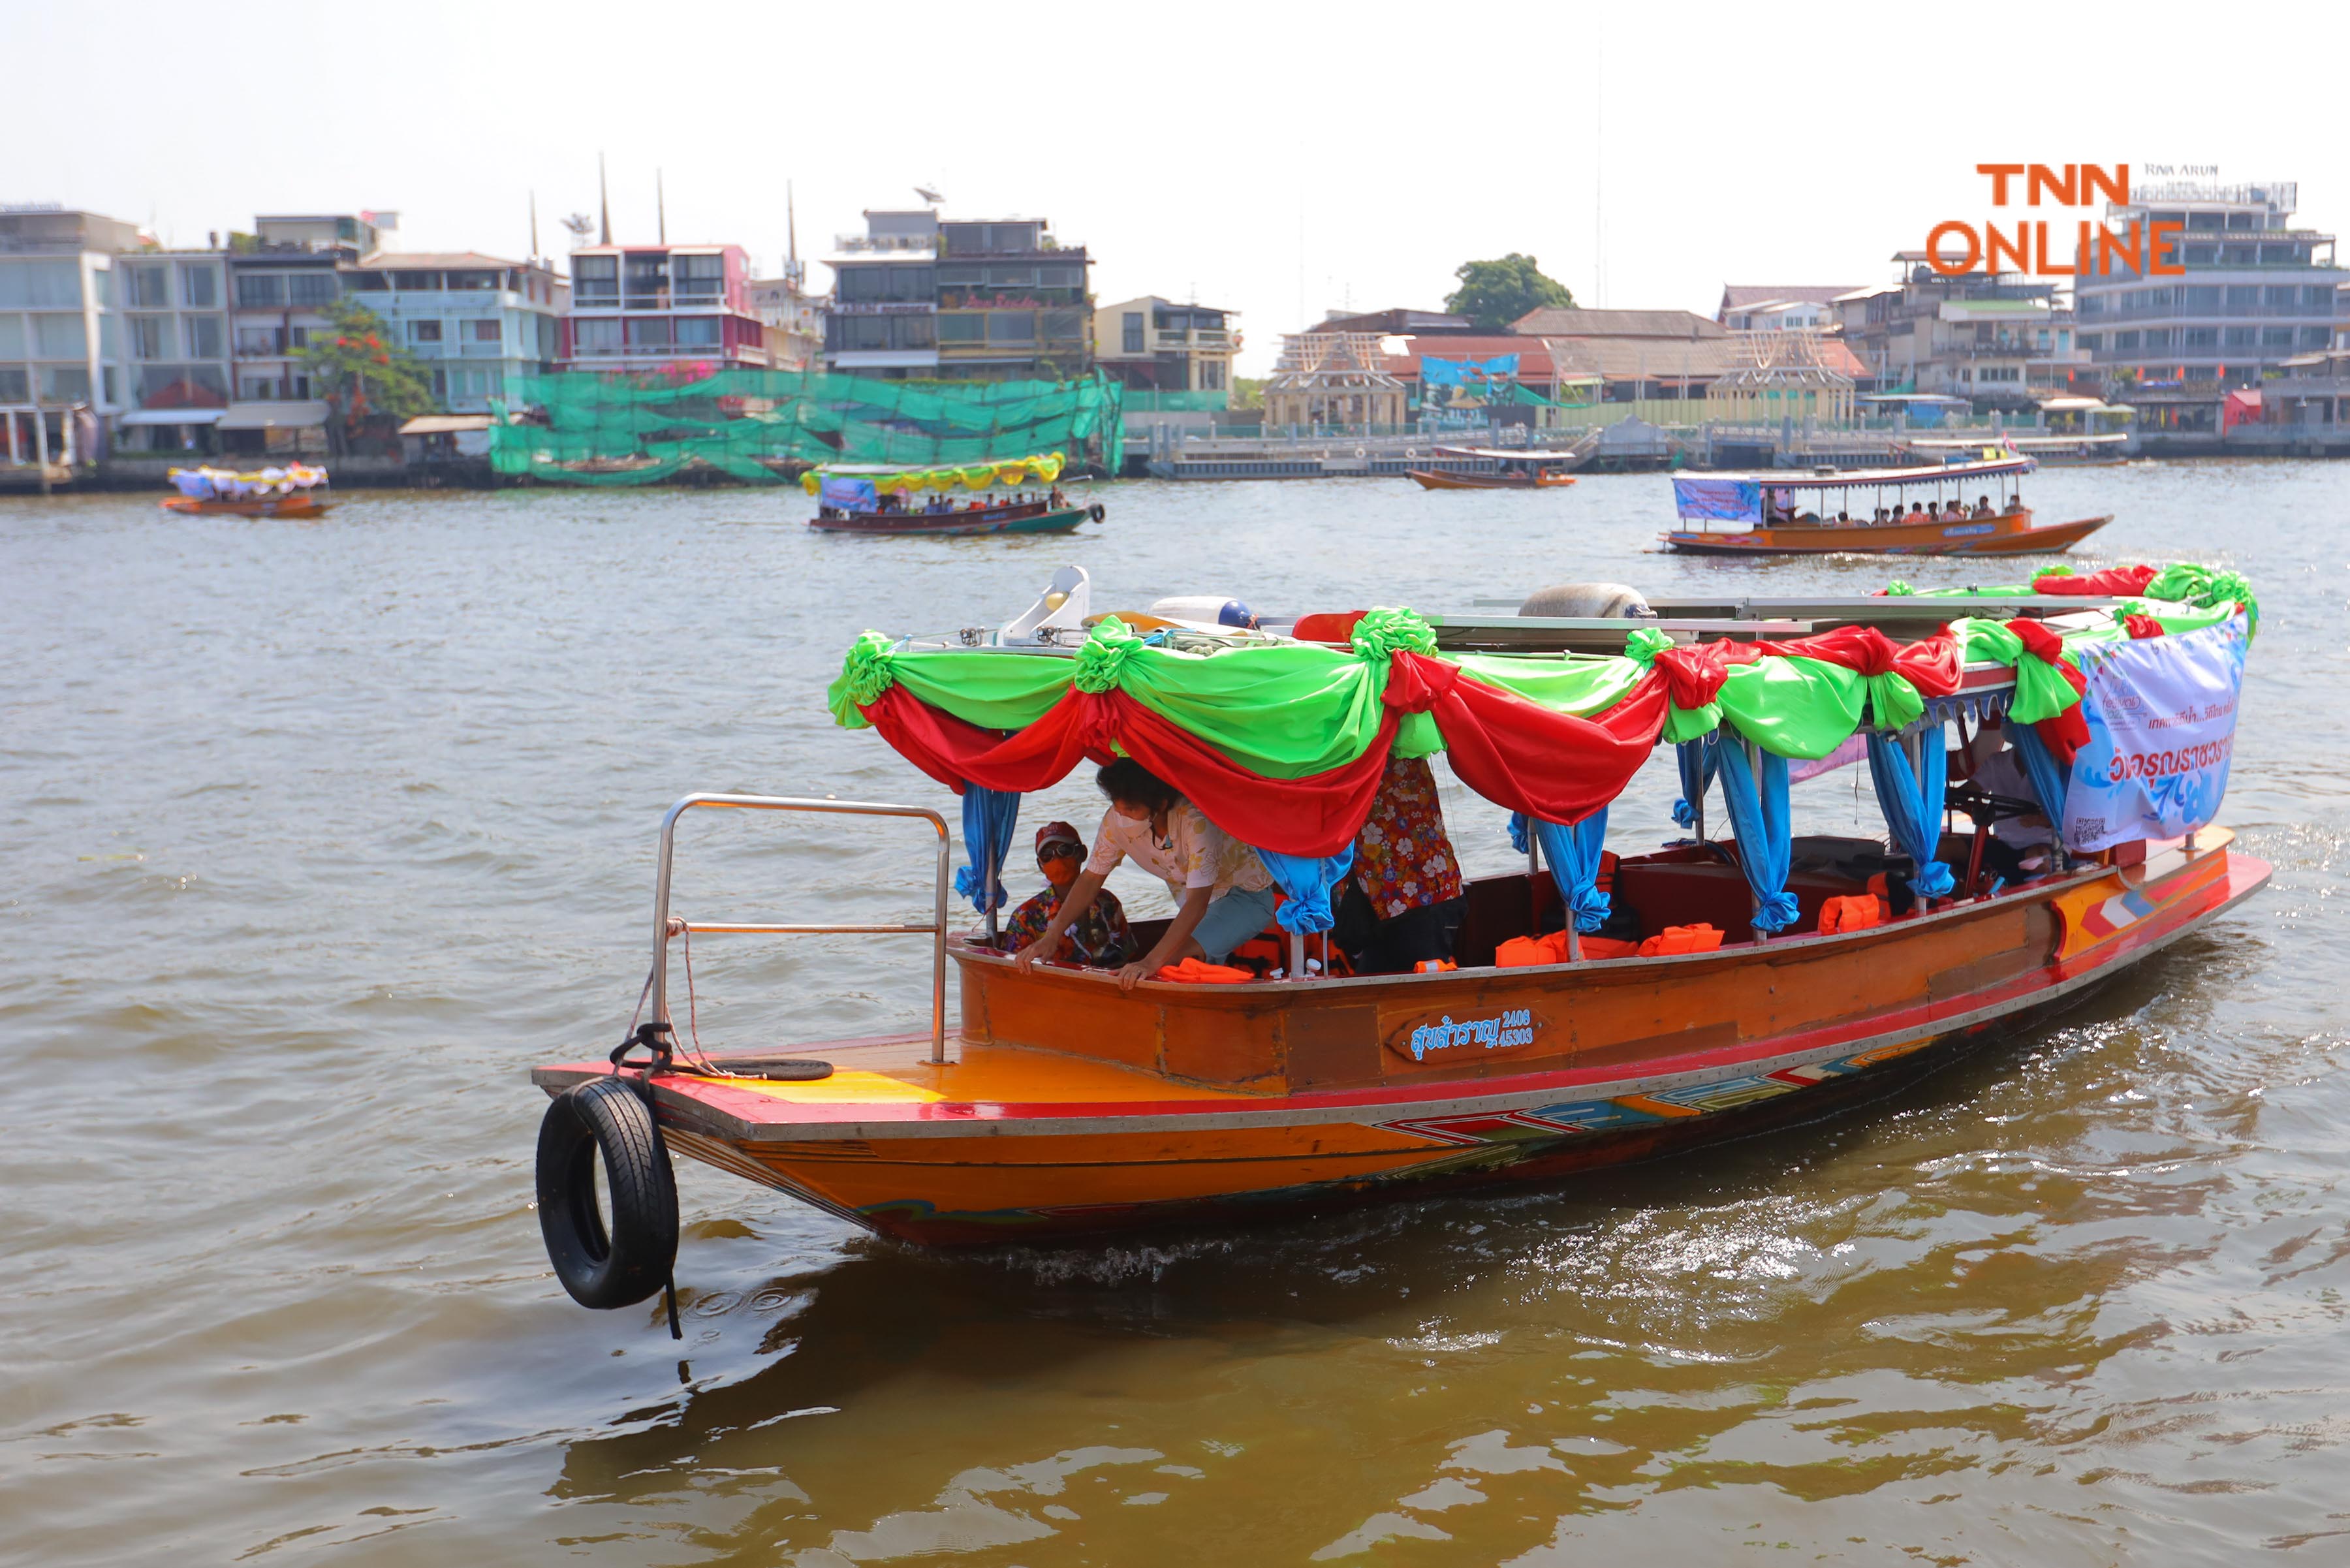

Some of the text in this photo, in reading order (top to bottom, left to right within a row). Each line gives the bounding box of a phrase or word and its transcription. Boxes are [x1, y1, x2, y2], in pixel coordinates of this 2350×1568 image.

[2180, 164, 2219, 176] ARUN
[1502, 1009, 1531, 1027] 2408
[1410, 1015, 1501, 1060] สุขสำราญ
[1498, 1027, 1533, 1047] 45303
